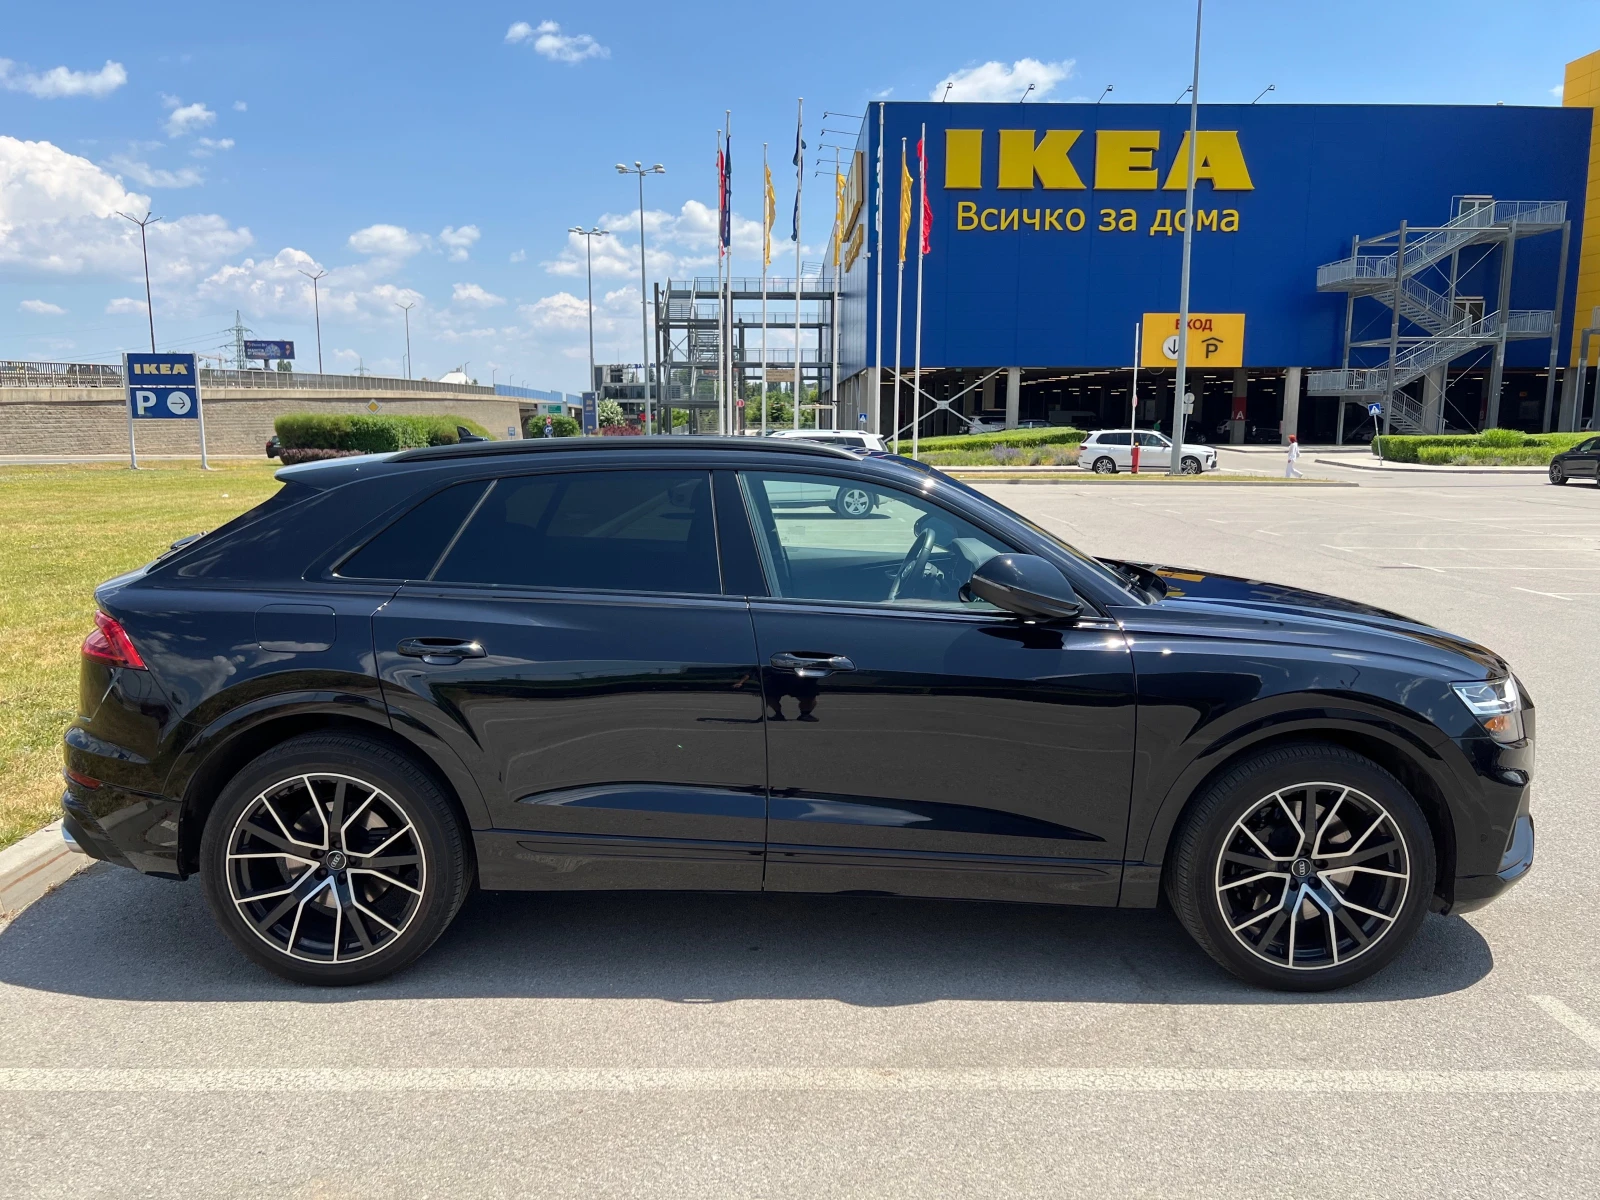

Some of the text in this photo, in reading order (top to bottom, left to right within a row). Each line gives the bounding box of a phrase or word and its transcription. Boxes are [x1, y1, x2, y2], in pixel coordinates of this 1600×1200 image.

[943, 129, 1255, 190] IKEA
[956, 201, 1240, 236] Всичко за дома
[1205, 343, 1219, 359] P
[134, 363, 188, 375] IKEA
[136, 390, 157, 415] P
